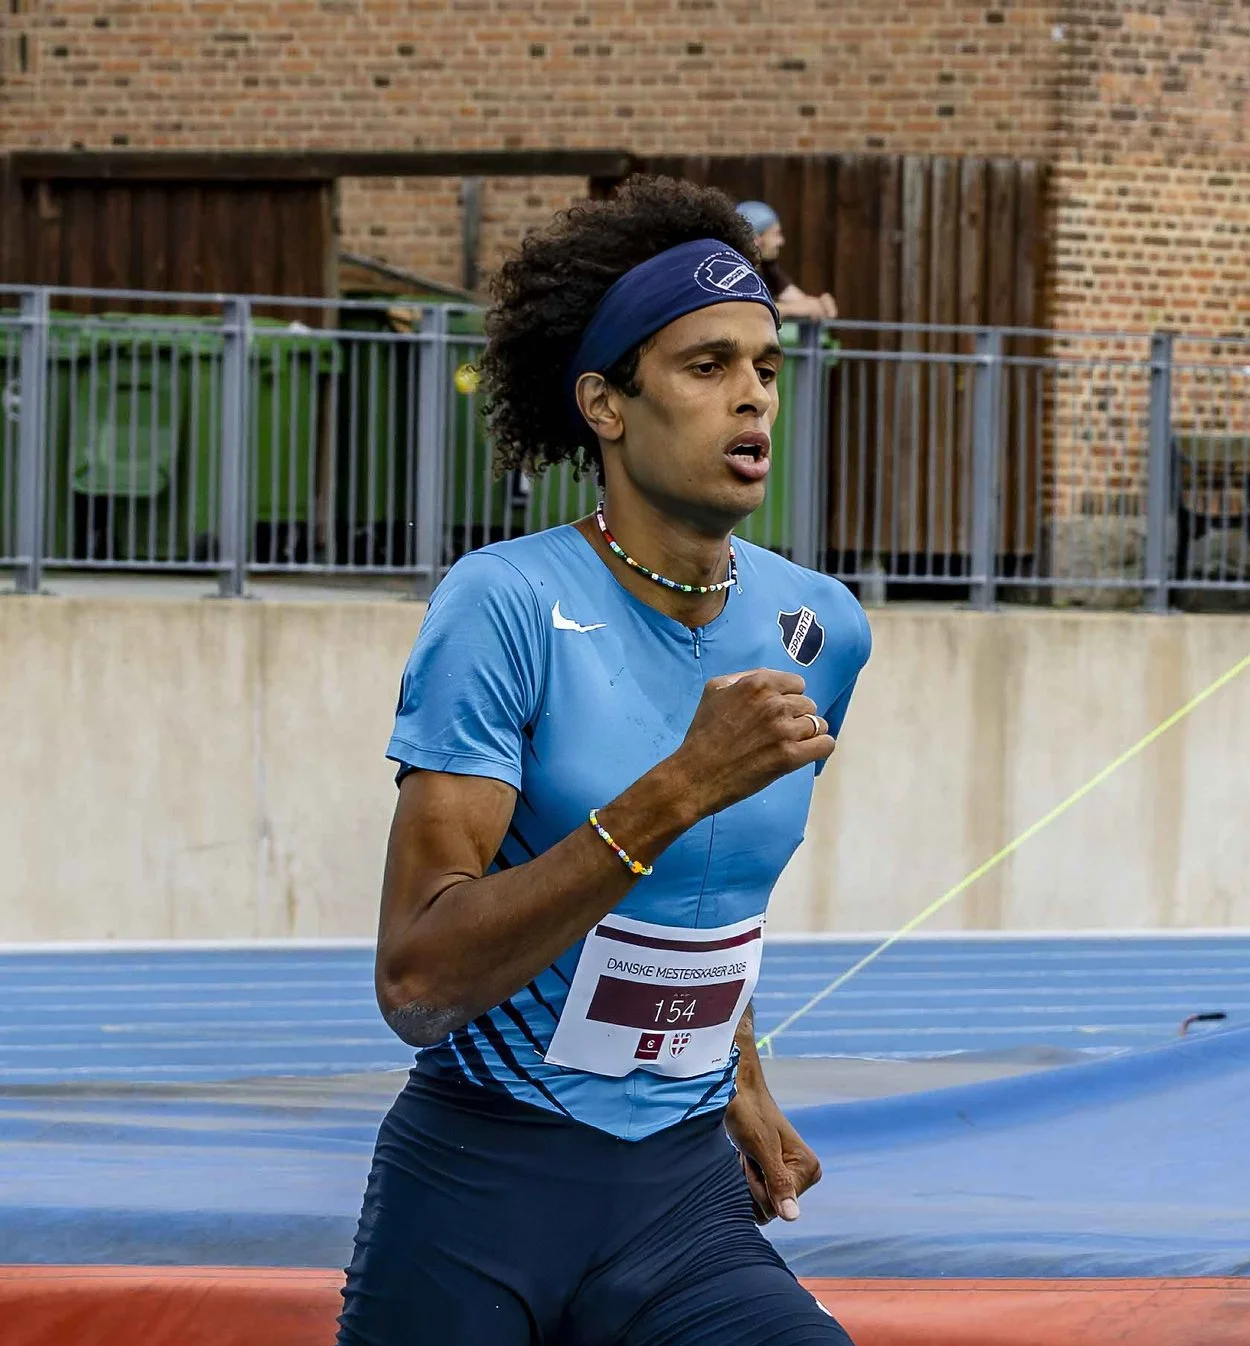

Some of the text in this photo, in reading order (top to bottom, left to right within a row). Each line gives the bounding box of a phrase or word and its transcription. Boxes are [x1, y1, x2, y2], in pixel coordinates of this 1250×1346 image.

[790, 610, 812, 656] SPARTA
[607, 957, 654, 977] DANSKE
[656, 964, 728, 980] MESTERSKABER
[654, 999, 698, 1024] 154
